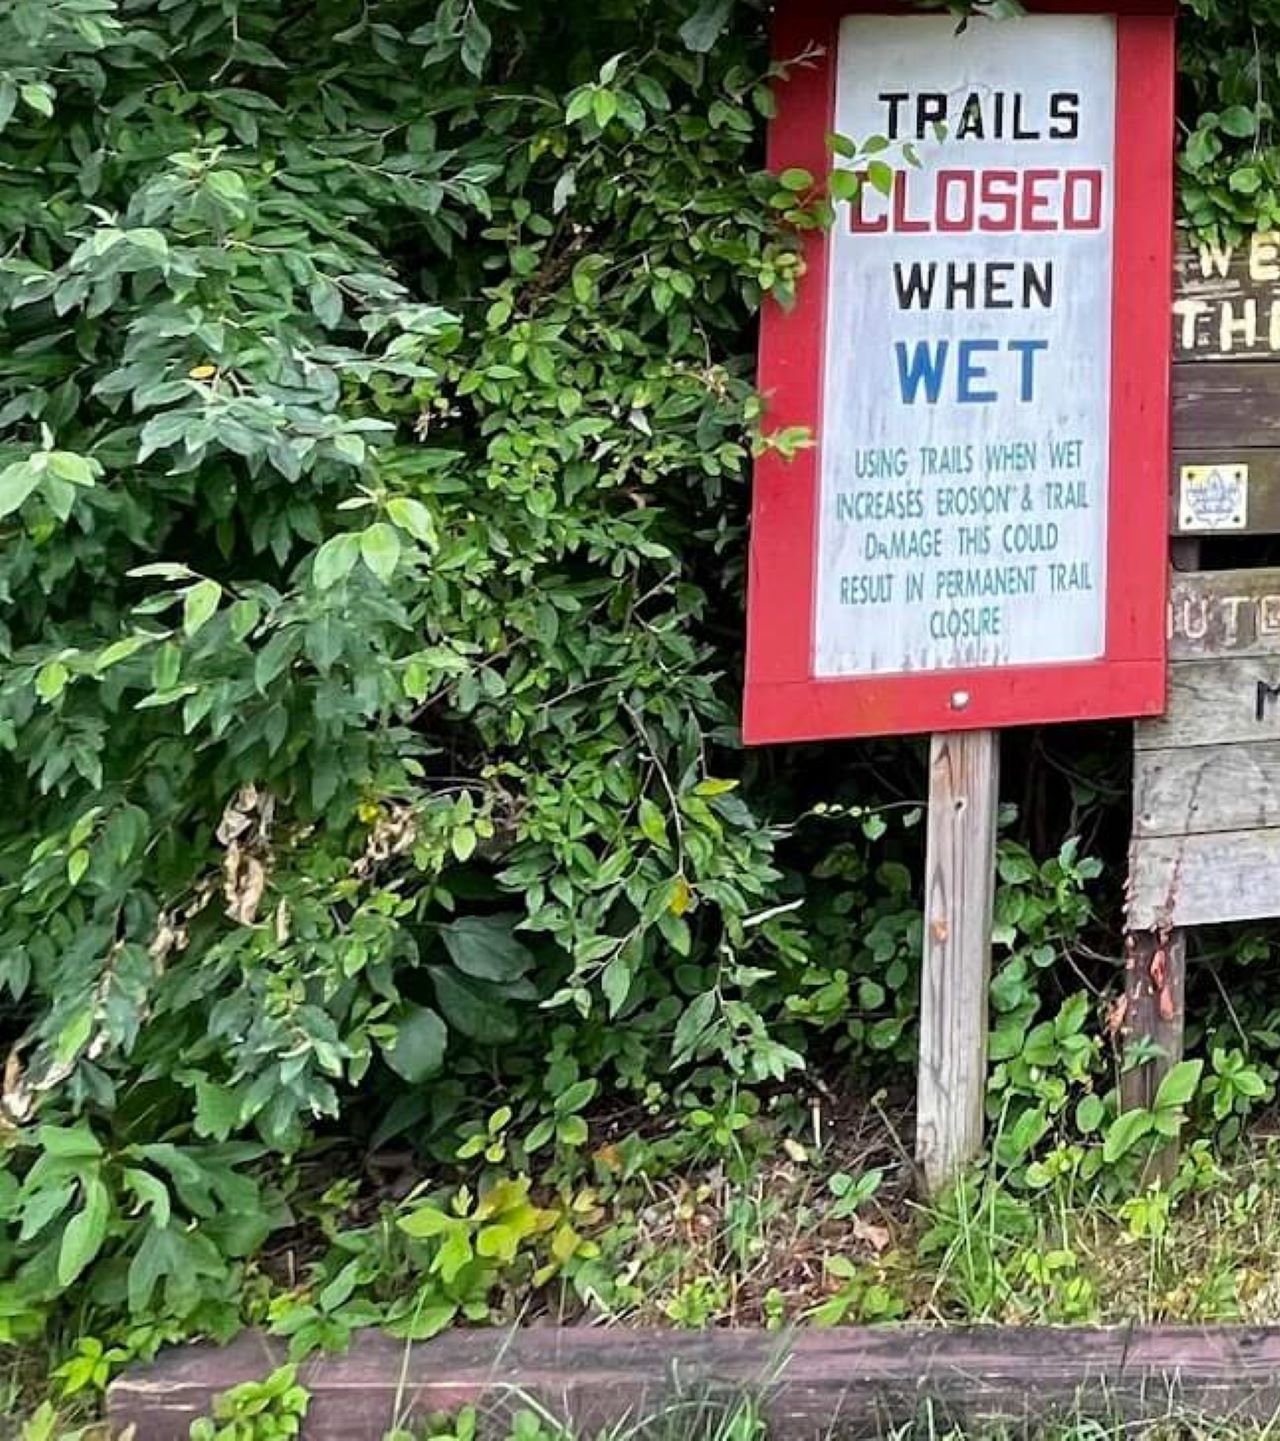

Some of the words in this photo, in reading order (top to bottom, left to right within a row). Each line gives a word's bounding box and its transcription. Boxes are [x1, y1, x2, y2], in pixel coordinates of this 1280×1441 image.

[879, 92, 1079, 140] TRAILS
[849, 169, 1101, 232] CLOSED
[893, 262, 1053, 310] WHEN
[895, 340, 1048, 404] WET
[855, 448, 908, 479] USING
[919, 444, 974, 476] TRAILS
[985, 442, 1037, 473] WHEN
[1048, 439, 1084, 469] WET
[836, 489, 924, 521] INCREASES
[936, 487, 1010, 516] EROSION
[1020, 486, 1033, 512] &
[1045, 481, 1089, 510] TRAIL
[957, 526, 991, 556] THIS
[1003, 522, 1059, 554] COULD
[840, 573, 893, 605] RESULT
[905, 570, 924, 601] IN
[935, 566, 1039, 599] PERMANENT
[1049, 562, 1093, 591] TRAIL
[929, 607, 1001, 639] CLOSURE
